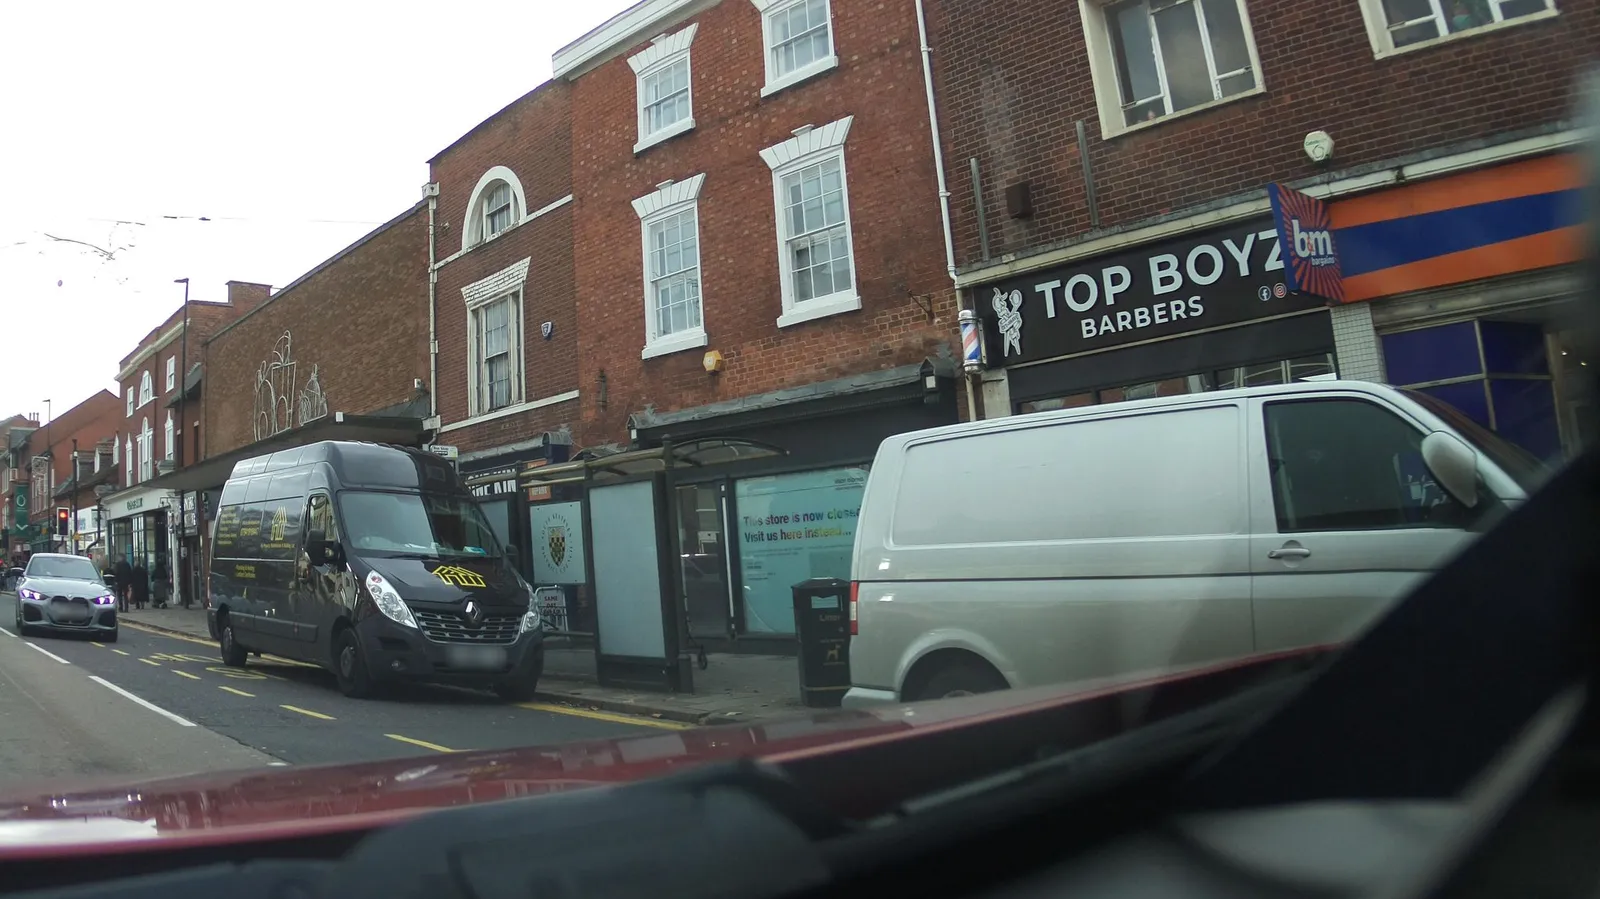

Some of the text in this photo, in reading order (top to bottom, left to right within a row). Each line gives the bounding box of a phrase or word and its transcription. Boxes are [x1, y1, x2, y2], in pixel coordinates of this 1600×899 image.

[1292, 219, 1333, 258] b&m
[1035, 228, 1285, 318] TOP BOYZ
[1311, 256, 1335, 267] bargains
[1081, 295, 1204, 339] BARBERS
[744, 516, 763, 527] This
[765, 513, 789, 526] store
[792, 511, 800, 523] is
[803, 511, 824, 522] now
[744, 531, 764, 543] Visit
[766, 531, 778, 541] us
[780, 528, 802, 540] here
